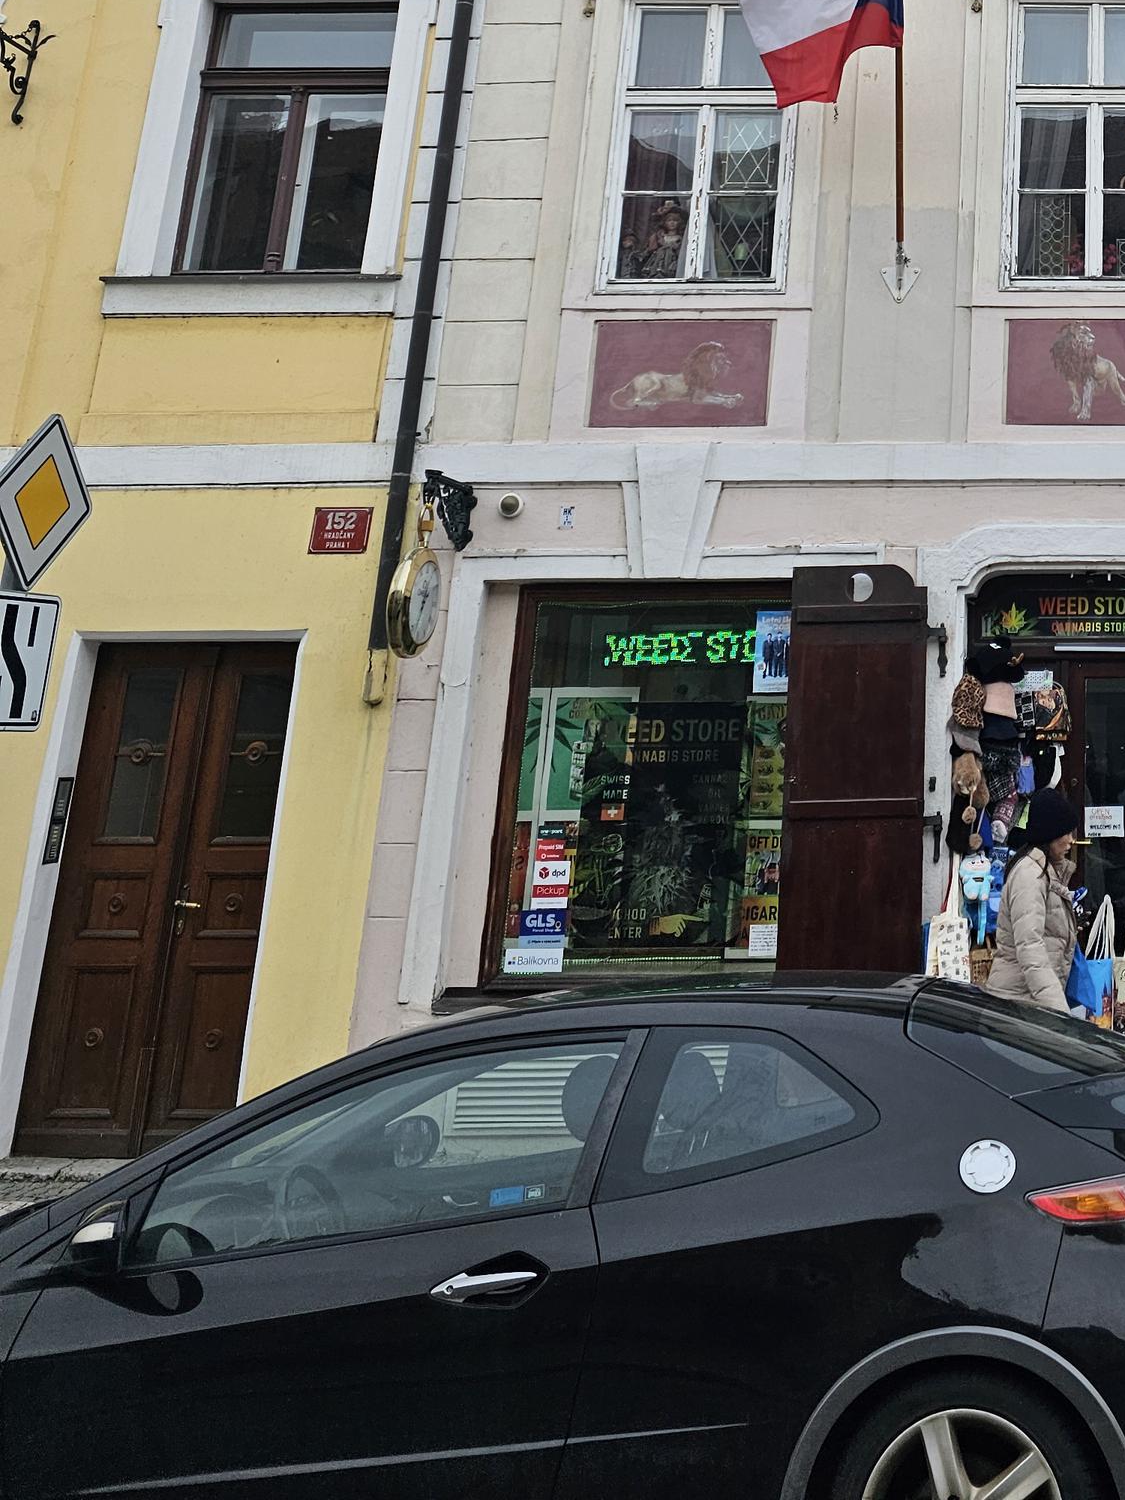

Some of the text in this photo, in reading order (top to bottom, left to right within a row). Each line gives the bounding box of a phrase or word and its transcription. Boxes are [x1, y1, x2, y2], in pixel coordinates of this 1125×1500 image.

[324, 511, 358, 530] 152
[323, 530, 355, 540] HRADČANY
[325, 541, 346, 549] PRAHA
[1038, 596, 1089, 615] WEED
[1051, 621, 1102, 633] CANNABIS
[604, 632, 700, 666] WEED
[672, 719, 740, 743] STORE
[682, 750, 720, 763] STORE
[600, 775, 631, 786] SWISS
[602, 789, 629, 800] MADE
[551, 868, 567, 878] dpd
[536, 886, 565, 896] Pickup
[525, 913, 556, 928] GLS
[517, 955, 559, 966] Balíkovna
